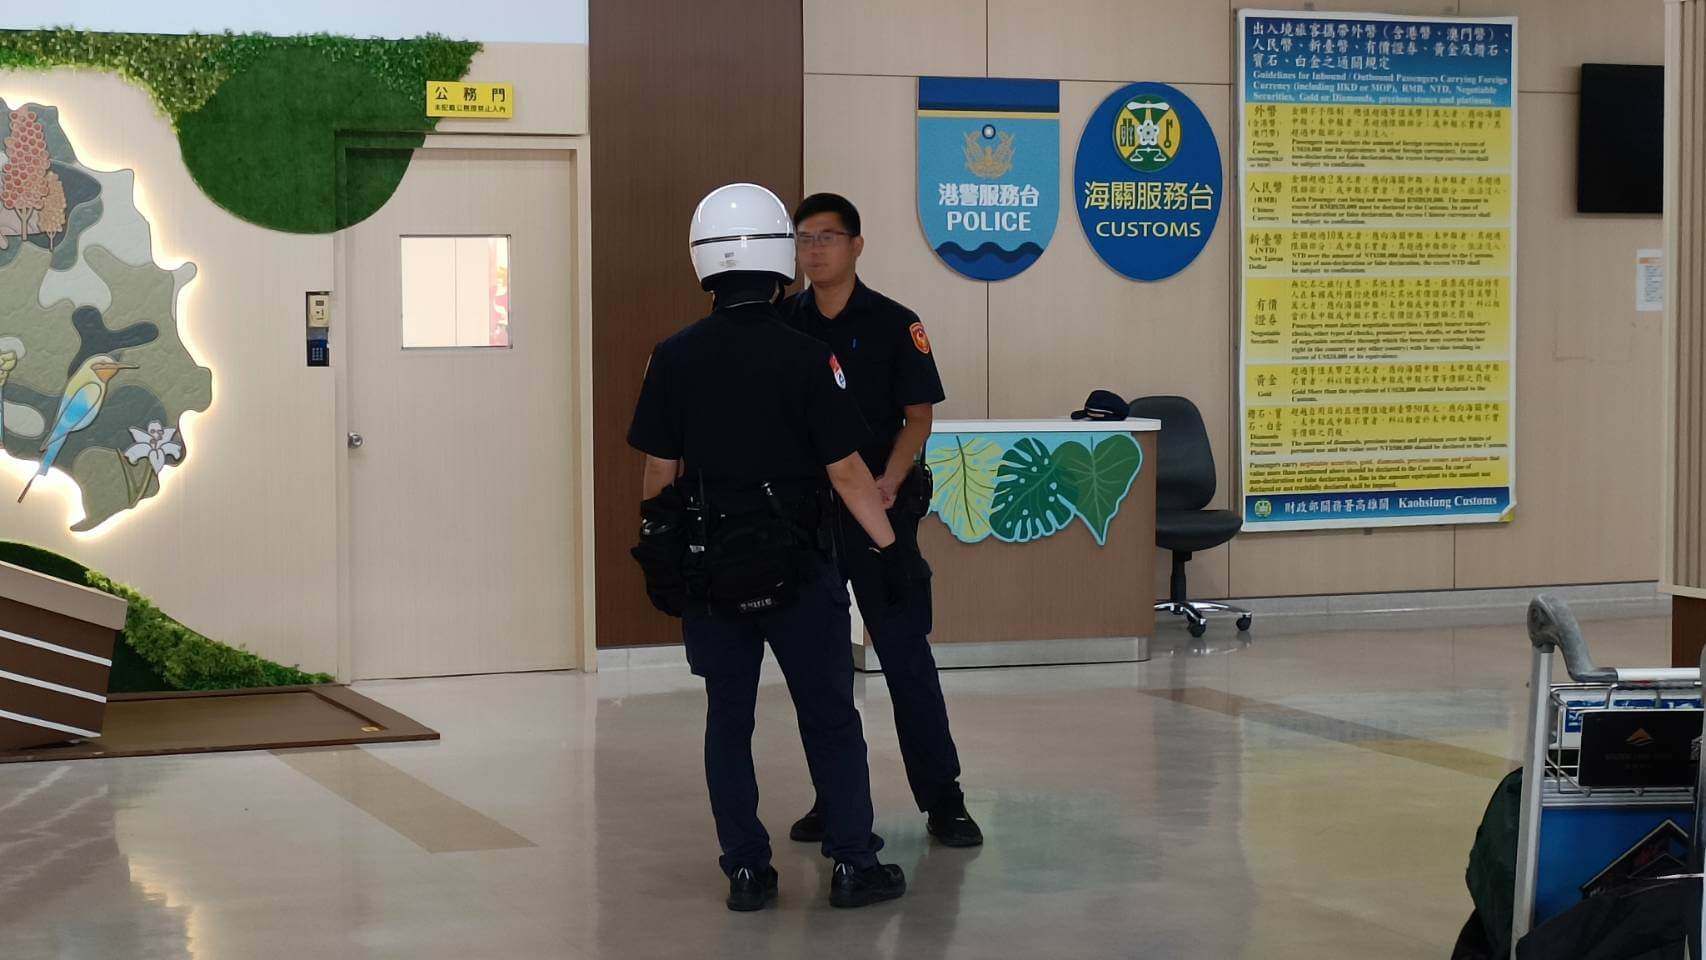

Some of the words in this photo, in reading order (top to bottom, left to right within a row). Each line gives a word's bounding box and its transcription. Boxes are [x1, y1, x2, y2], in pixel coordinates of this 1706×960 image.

[1252, 70, 1296, 79] Guidelines
[1297, 71, 1311, 79] for
[1311, 71, 1346, 80] Inbound
[1352, 72, 1395, 81] Outbound
[1395, 73, 1438, 84] Passengers
[1439, 74, 1477, 84] Carrying
[1477, 74, 1509, 85] Foreign
[1299, 93, 1319, 101] Gold
[1254, 105, 1277, 118] 外幣
[1249, 181, 1282, 193] 人民幣
[938, 183, 1040, 208] 港警服務台
[1084, 181, 1214, 211] 海關服務台
[946, 211, 1032, 232] POLICE
[1096, 221, 1202, 238] CUSTOMS
[1249, 232, 1282, 246] 新臺幣
[1256, 298, 1278, 311] 有價
[1256, 374, 1278, 387] 黃金
[1398, 496, 1452, 509] Kaohsiung
[1454, 494, 1497, 506] Customs
